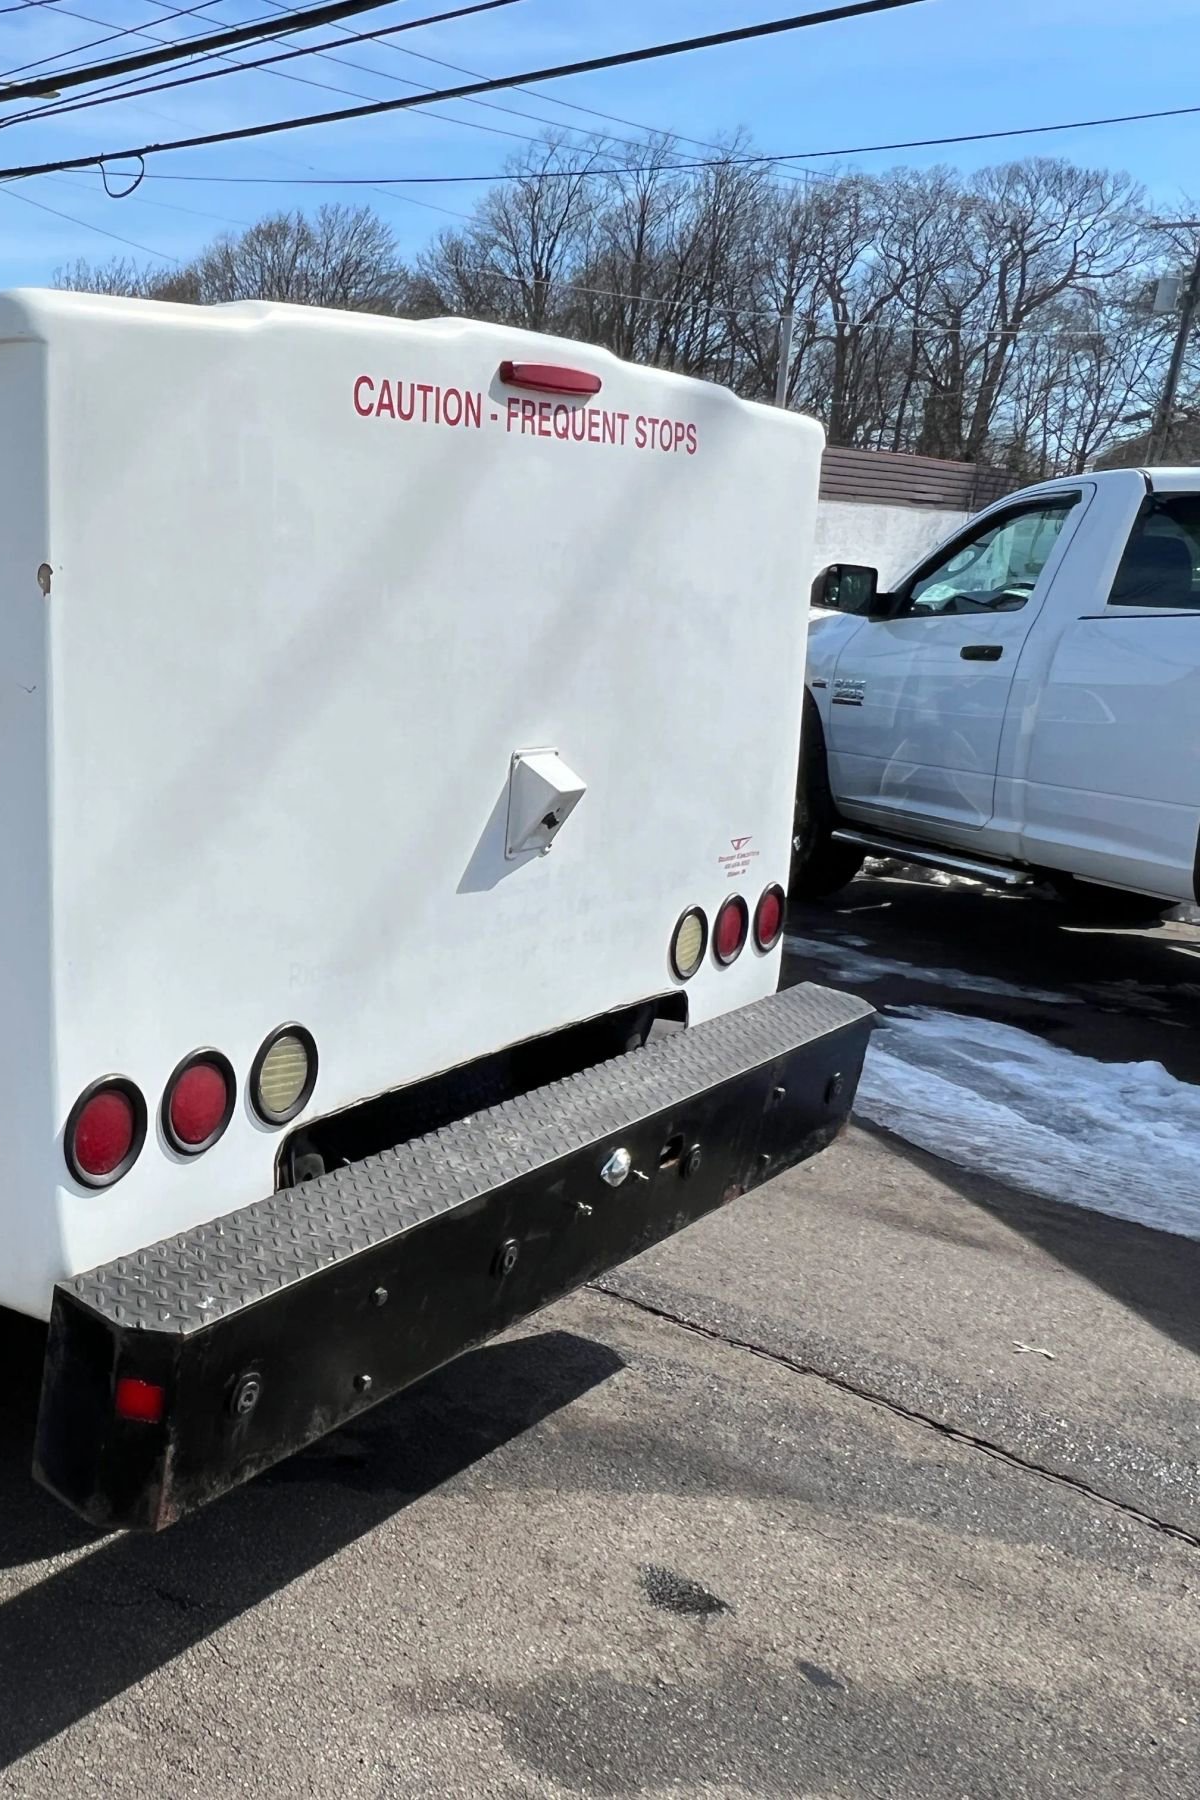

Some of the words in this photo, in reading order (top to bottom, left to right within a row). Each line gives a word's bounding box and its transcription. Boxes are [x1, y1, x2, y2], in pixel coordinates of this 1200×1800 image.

[352, 374, 483, 429] CAUTION
[505, 397, 631, 446] FREQUENT
[633, 415, 698, 456] STOPS
